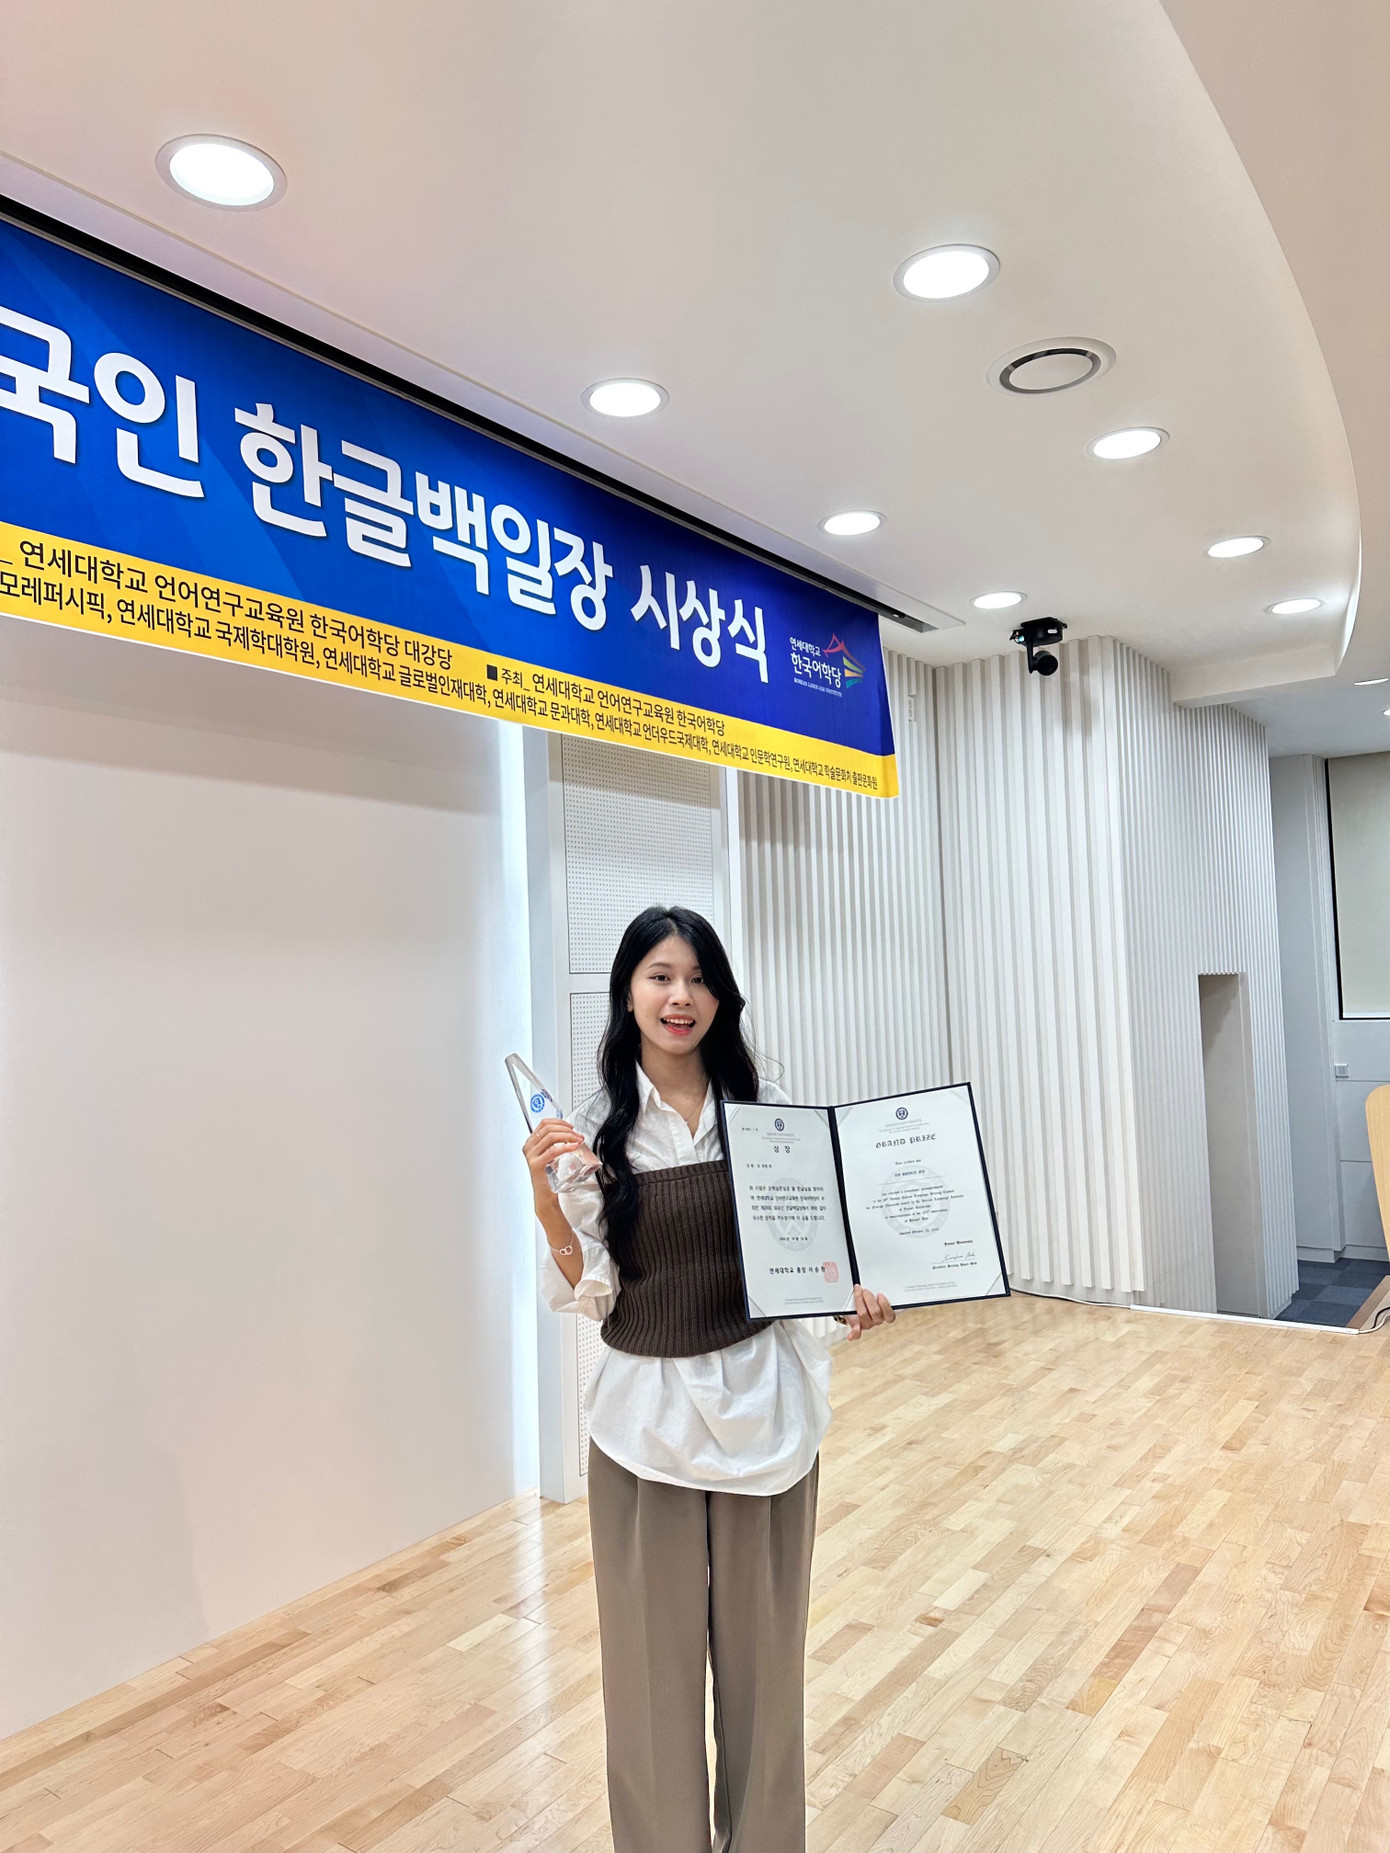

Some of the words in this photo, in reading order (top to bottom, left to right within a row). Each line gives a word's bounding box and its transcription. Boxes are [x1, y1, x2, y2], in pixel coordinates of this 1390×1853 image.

[0, 305, 204, 499] 국인
[234, 402, 612, 631] 한글백일장
[630, 564, 769, 684] 시상식
[19, 540, 148, 594] 연세대학교
[154, 574, 304, 634] 언어연구교육원
[309, 613, 400, 657] 한국어학당
[404, 640, 453, 670] 대강당
[789, 636, 821, 657] 연세대학교
[790, 652, 842, 689] 한국어학당
[117, 598, 212, 640] 연세대학교
[215, 619, 320, 669] 국제학대학원,
[323, 646, 396, 682] 연세대학교
[399, 664, 491, 708] 글로벌인재대학,
[492, 688, 548, 718] 연세대학교
[550, 701, 594, 730] 문과대학,
[594, 712, 642, 737] 연세대학교
[642, 724, 712, 756] 언더우드국제대학,
[712, 739, 749, 761] 연세대학교
[750, 747, 793, 774] 인문학연구원,
[793, 757, 824, 777] 연세대학교
[532, 673, 595, 705] 연세대학교
[597, 690, 675, 725] 언어연구교육원
[677, 709, 725, 737] 한국어학당
[909, 1133, 936, 1144] PRIZE
